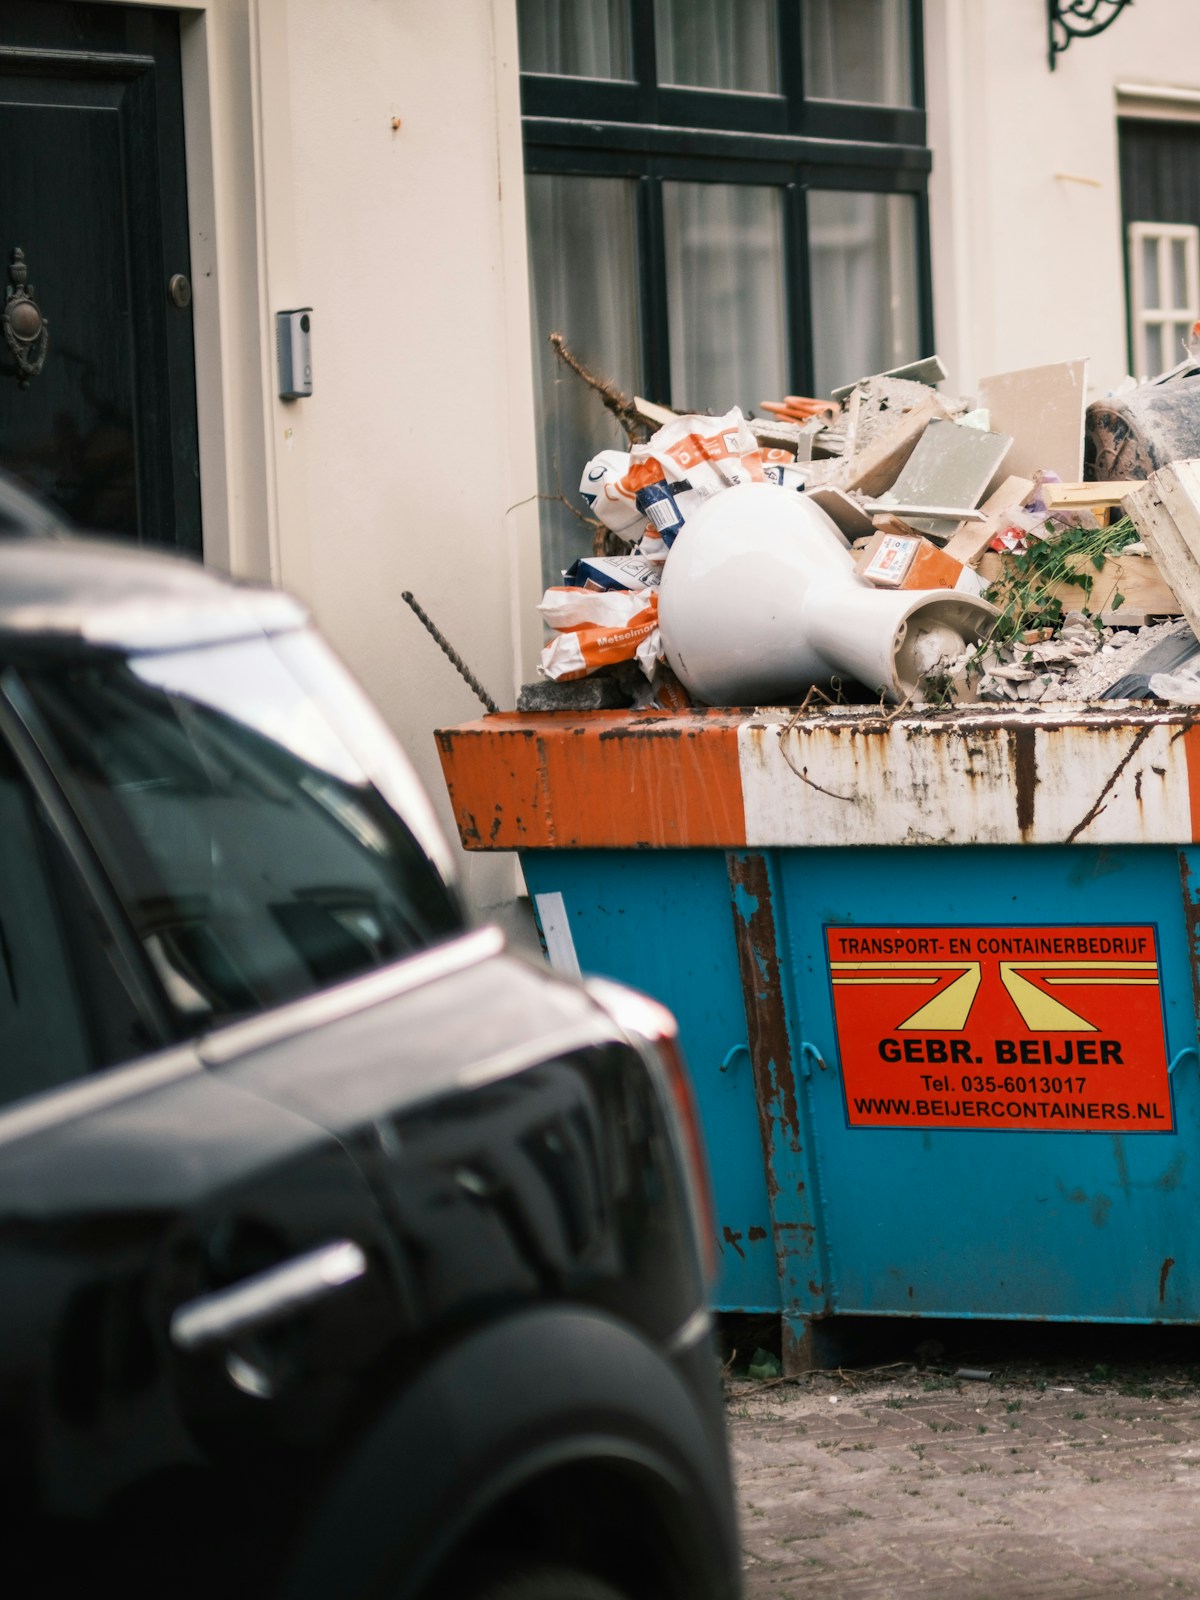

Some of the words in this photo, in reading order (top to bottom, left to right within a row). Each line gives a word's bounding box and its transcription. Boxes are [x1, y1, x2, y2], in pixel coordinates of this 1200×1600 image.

[838, 937, 945, 954] TRANSPORT-
[950, 938, 972, 954] EN
[976, 937, 1148, 955] CONTAINERBEDRIJF
[877, 1038, 983, 1064] GEBR.
[994, 1040, 1124, 1065] BEIJER
[920, 1075, 956, 1092] Tel.
[960, 1075, 1087, 1094] 035-6013017
[853, 1097, 1165, 1119] WWW.BEIJERCONTAINERS.NL
